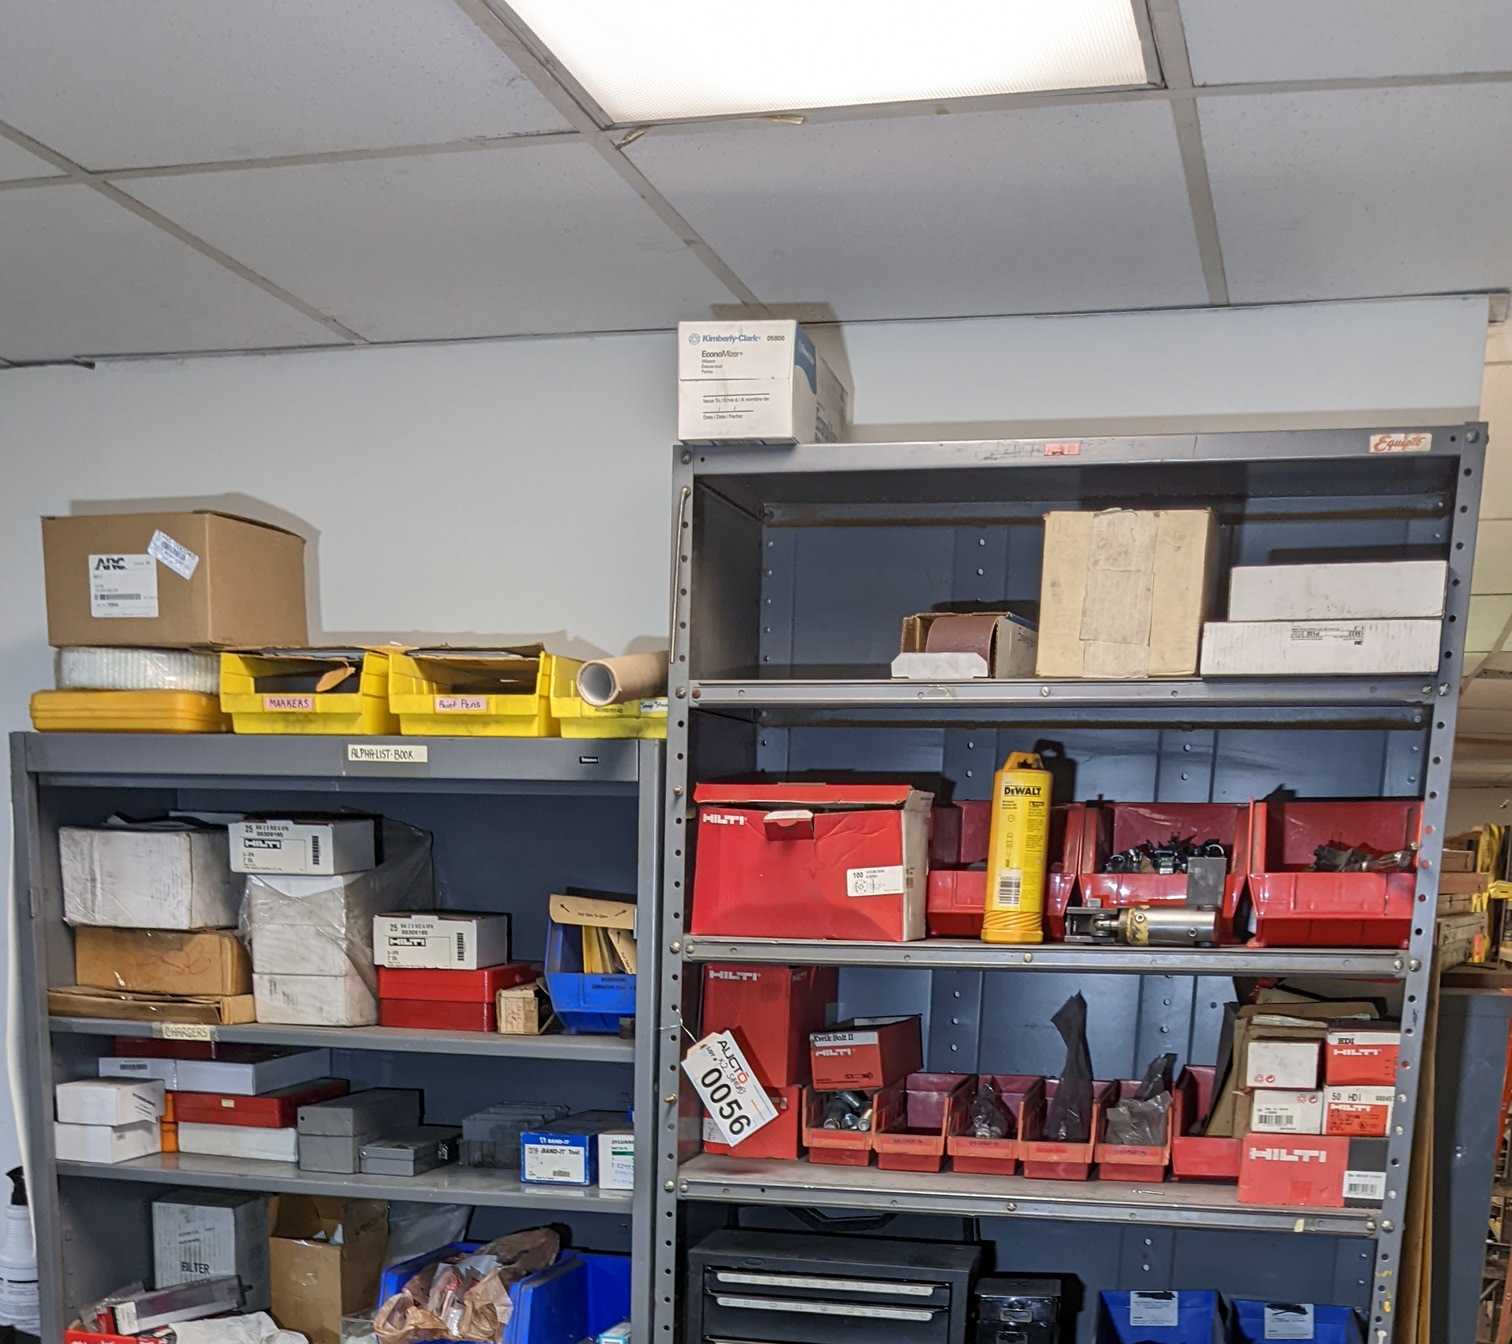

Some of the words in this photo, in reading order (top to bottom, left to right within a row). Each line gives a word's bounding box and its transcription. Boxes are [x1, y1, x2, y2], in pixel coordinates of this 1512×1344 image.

[702, 813, 747, 826] HILTI
[709, 970, 760, 981] HILTI
[815, 1048, 853, 1056] HILTI
[701, 1068, 751, 1136] 0056
[1330, 1103, 1371, 1112] HILTI
[1250, 1147, 1327, 1163] HILTI
